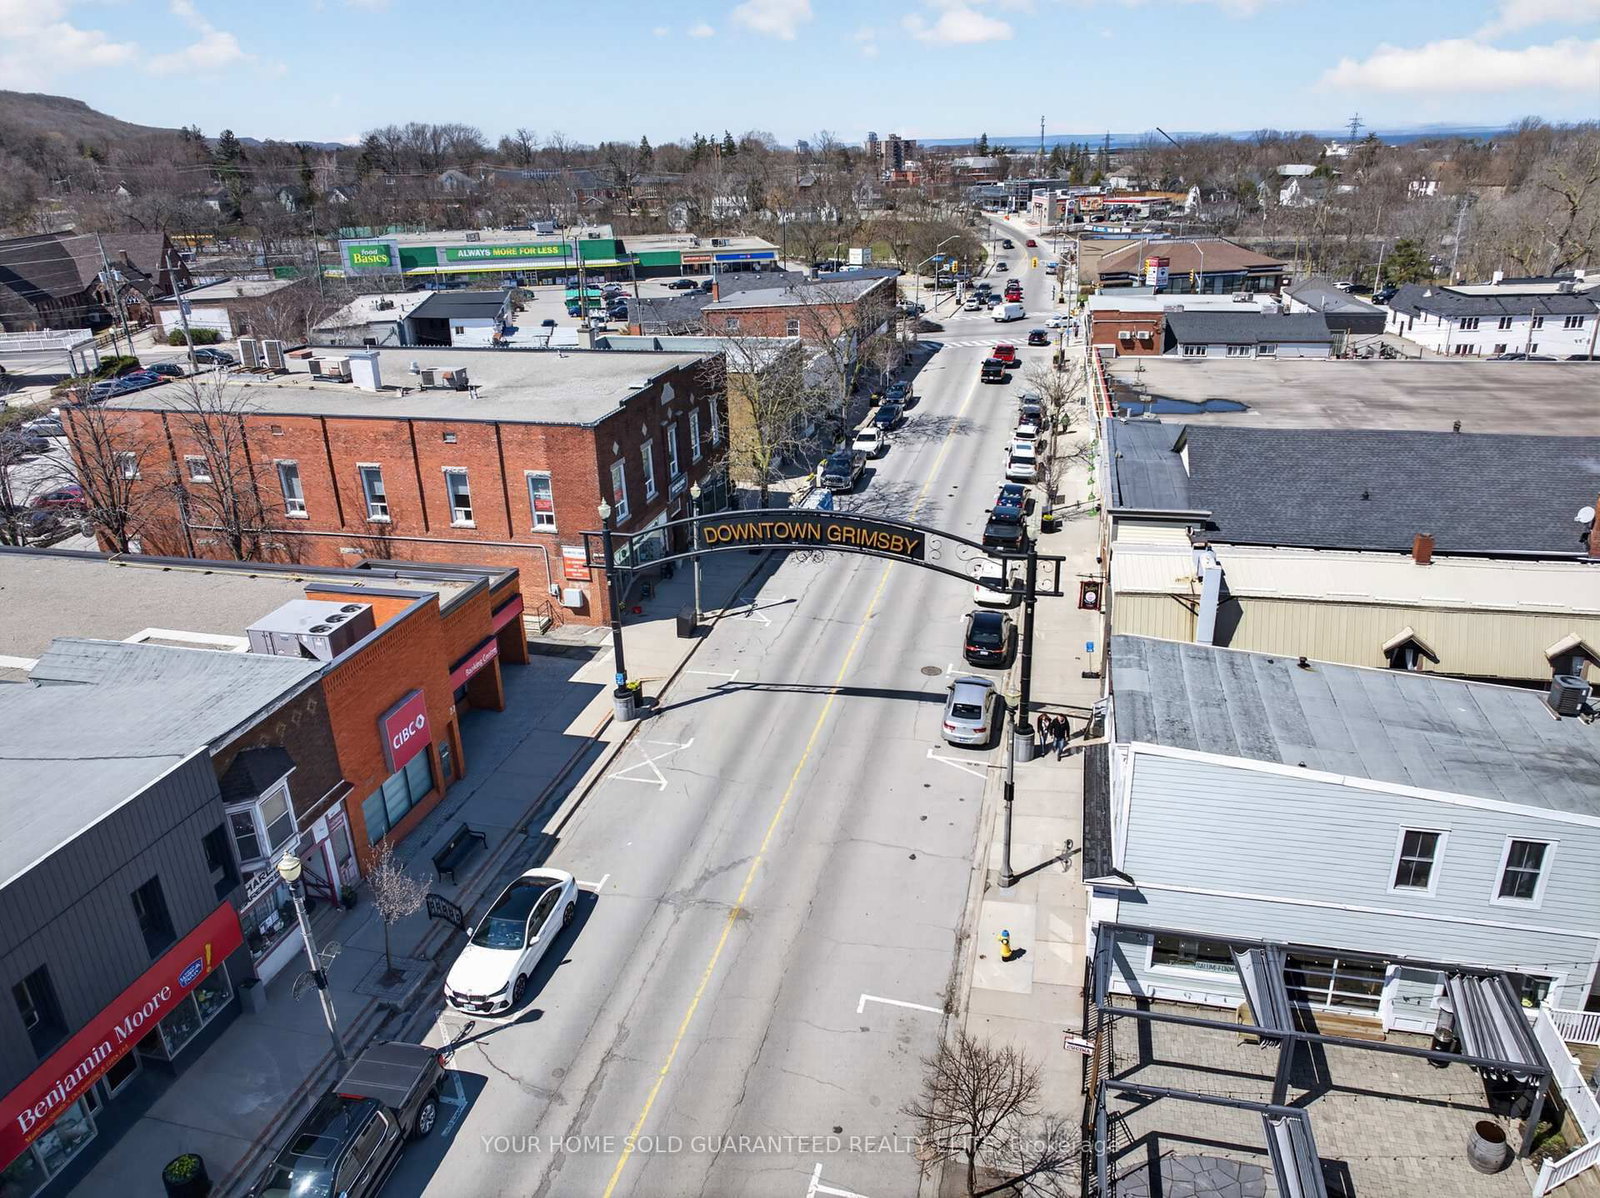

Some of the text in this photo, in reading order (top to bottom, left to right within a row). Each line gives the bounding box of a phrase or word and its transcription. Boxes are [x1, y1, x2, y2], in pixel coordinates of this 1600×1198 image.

[353, 253, 387, 264] Basics
[361, 247, 379, 255] food
[457, 246, 559, 257] ALWAYS MORE FOR LESS
[703, 522, 919, 555] DOWNTOWN GRIMSBY
[393, 720, 416, 750] CIBC
[16, 1040, 112, 1135] Benjamin
[113, 984, 173, 1044] Moore
